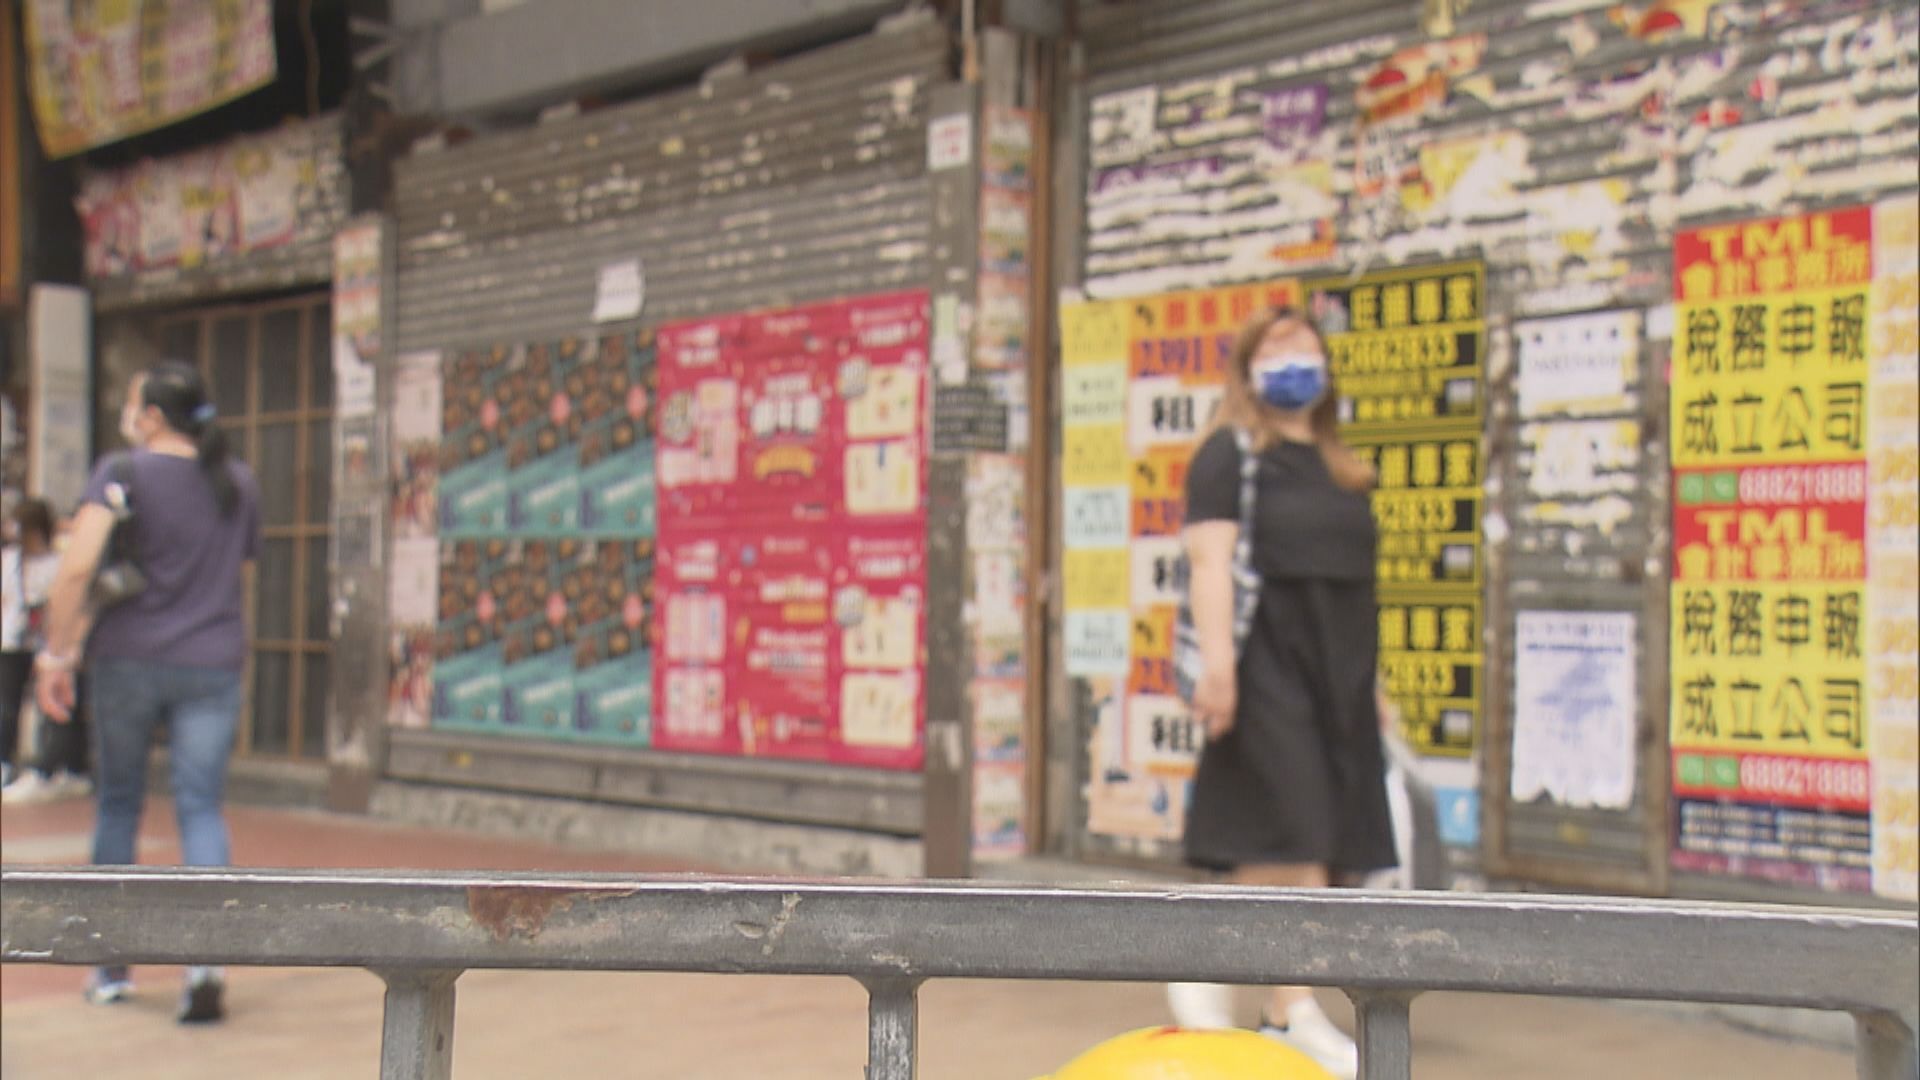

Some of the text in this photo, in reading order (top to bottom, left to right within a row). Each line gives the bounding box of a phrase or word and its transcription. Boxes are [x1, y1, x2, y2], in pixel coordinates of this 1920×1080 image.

[1699, 214, 1852, 263] TML
[1684, 381, 1864, 455] 成立公司
[1695, 509, 1842, 545] TML
[1682, 673, 1862, 748] 成立公司
